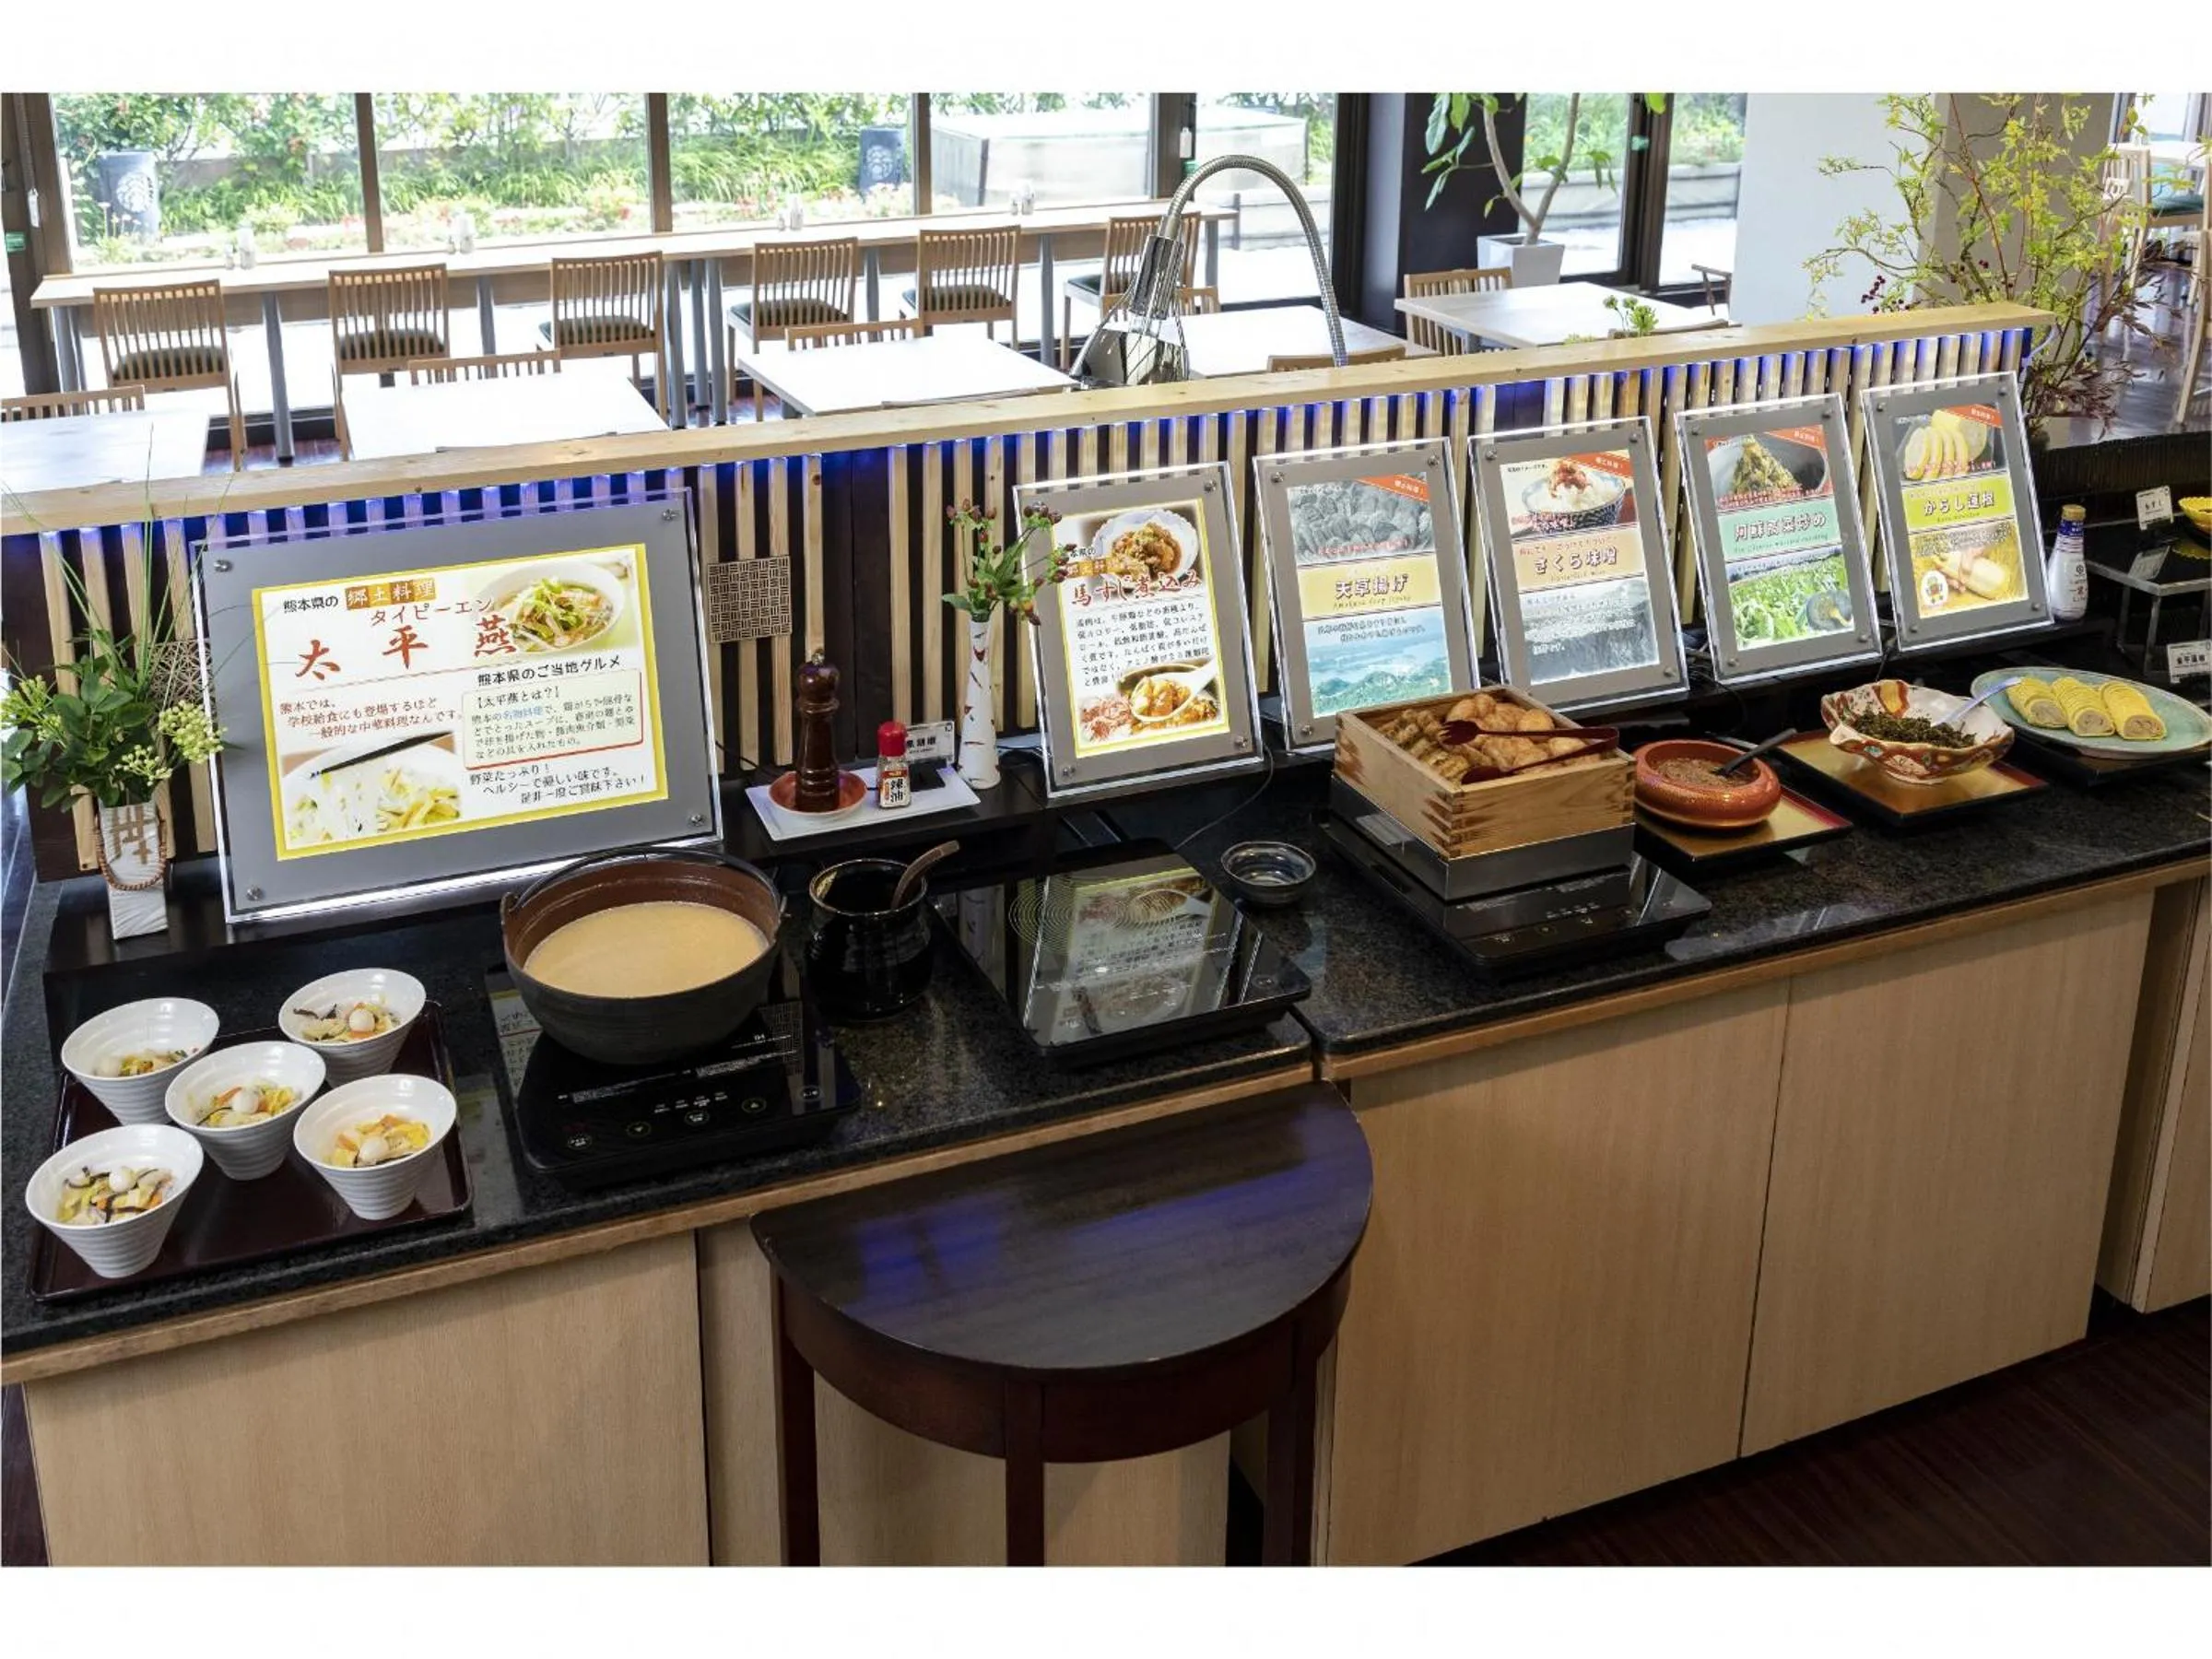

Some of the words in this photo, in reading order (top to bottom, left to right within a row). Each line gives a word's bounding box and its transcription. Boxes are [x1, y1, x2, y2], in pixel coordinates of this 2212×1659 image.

[1533, 546, 1618, 575] さくら味噌
[347, 580, 435, 610] 郷土料理
[1072, 569, 1201, 606] 馬すじ煮込み
[1335, 573, 1409, 600] 天草揚げ
[283, 595, 339, 614] 熊本県の
[371, 597, 493, 627] タイピーエン
[295, 615, 518, 681] 太平燕
[477, 654, 621, 687] 熊本県のご当地グルメ
[288, 696, 438, 728] 学校給食にも登場するほど
[309, 711, 463, 739] 一般的な中華料理なんです。
